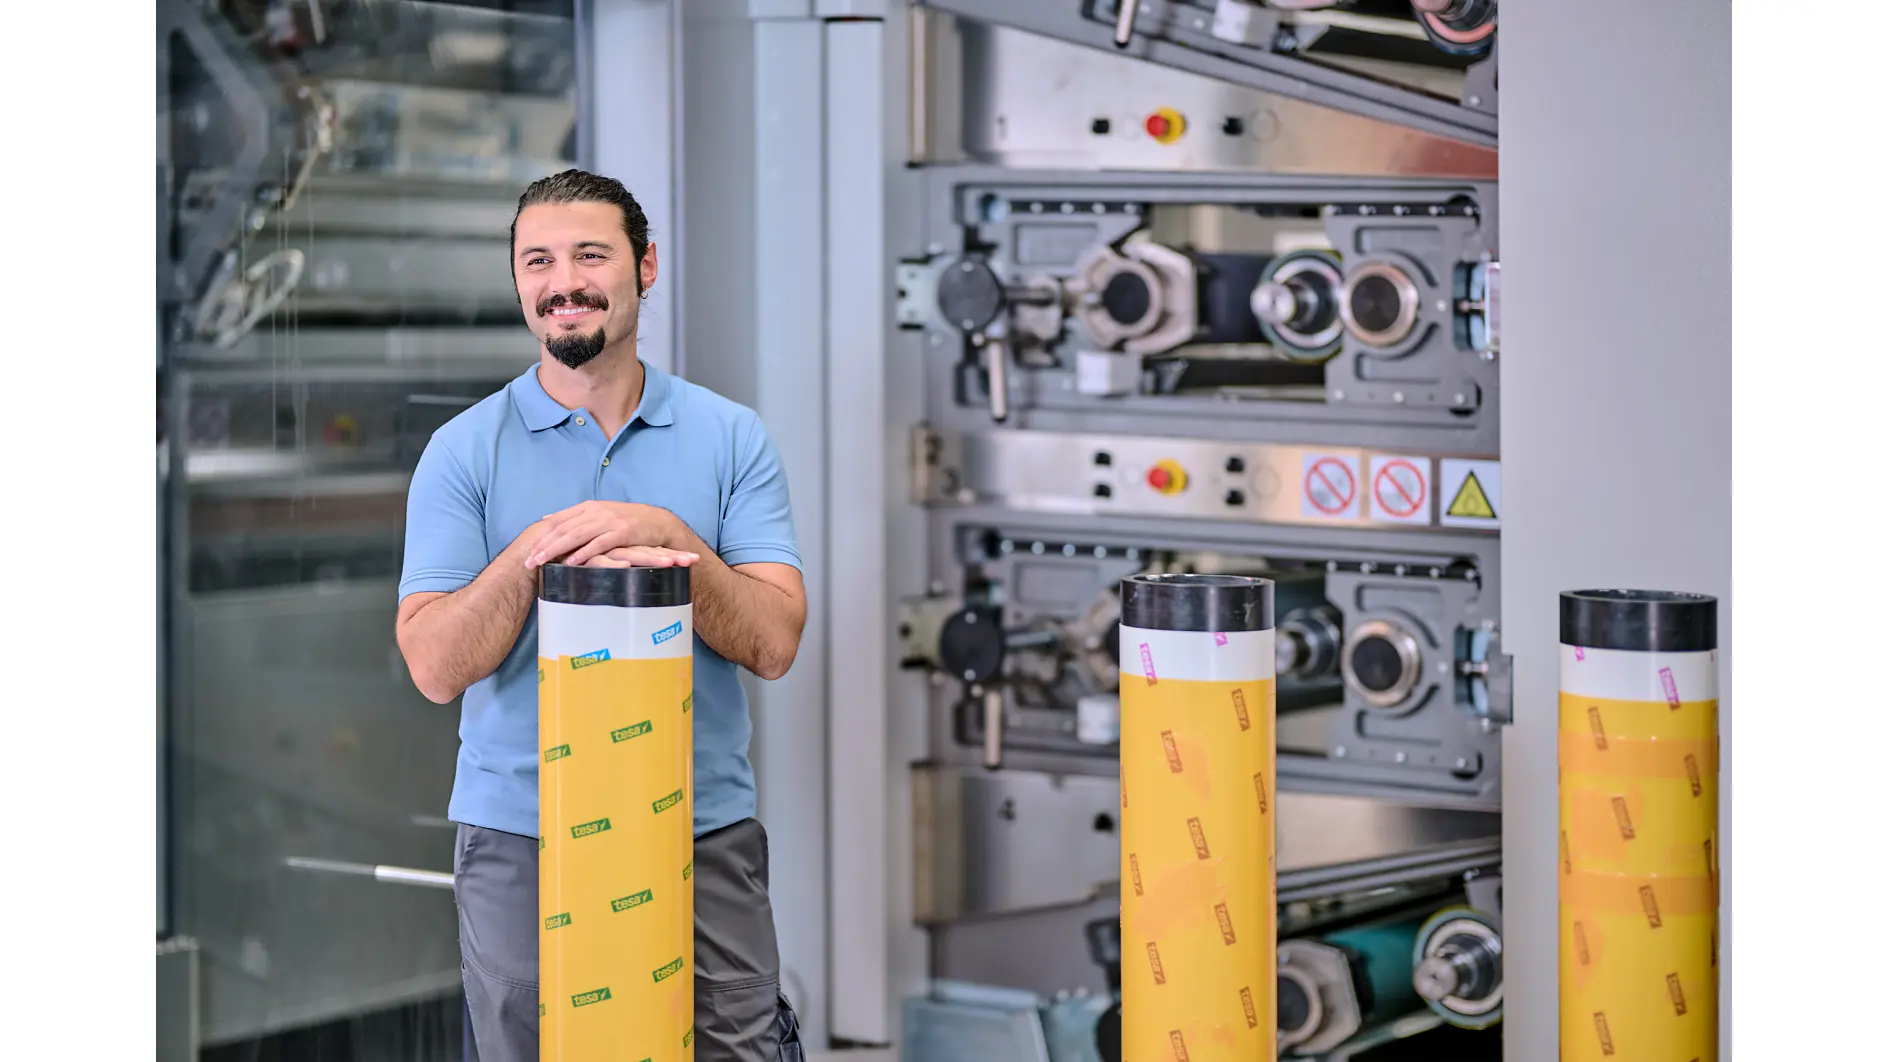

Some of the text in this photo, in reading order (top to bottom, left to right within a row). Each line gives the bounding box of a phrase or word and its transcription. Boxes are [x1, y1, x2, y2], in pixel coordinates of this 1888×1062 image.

[653, 625, 677, 644] tesa
[572, 652, 602, 669] tesa
[612, 723, 643, 742] tesa
[545, 747, 563, 762] tesa
[653, 793, 678, 813] tesa
[572, 821, 602, 838] tesa
[612, 893, 643, 911] tesa
[545, 915, 563, 930] tesa
[1214, 904, 1233, 936] tesa
[1147, 943, 1162, 976] tesa
[653, 961, 678, 981] tesa
[572, 990, 602, 1007] tesa
[1240, 988, 1254, 1021] tesa
